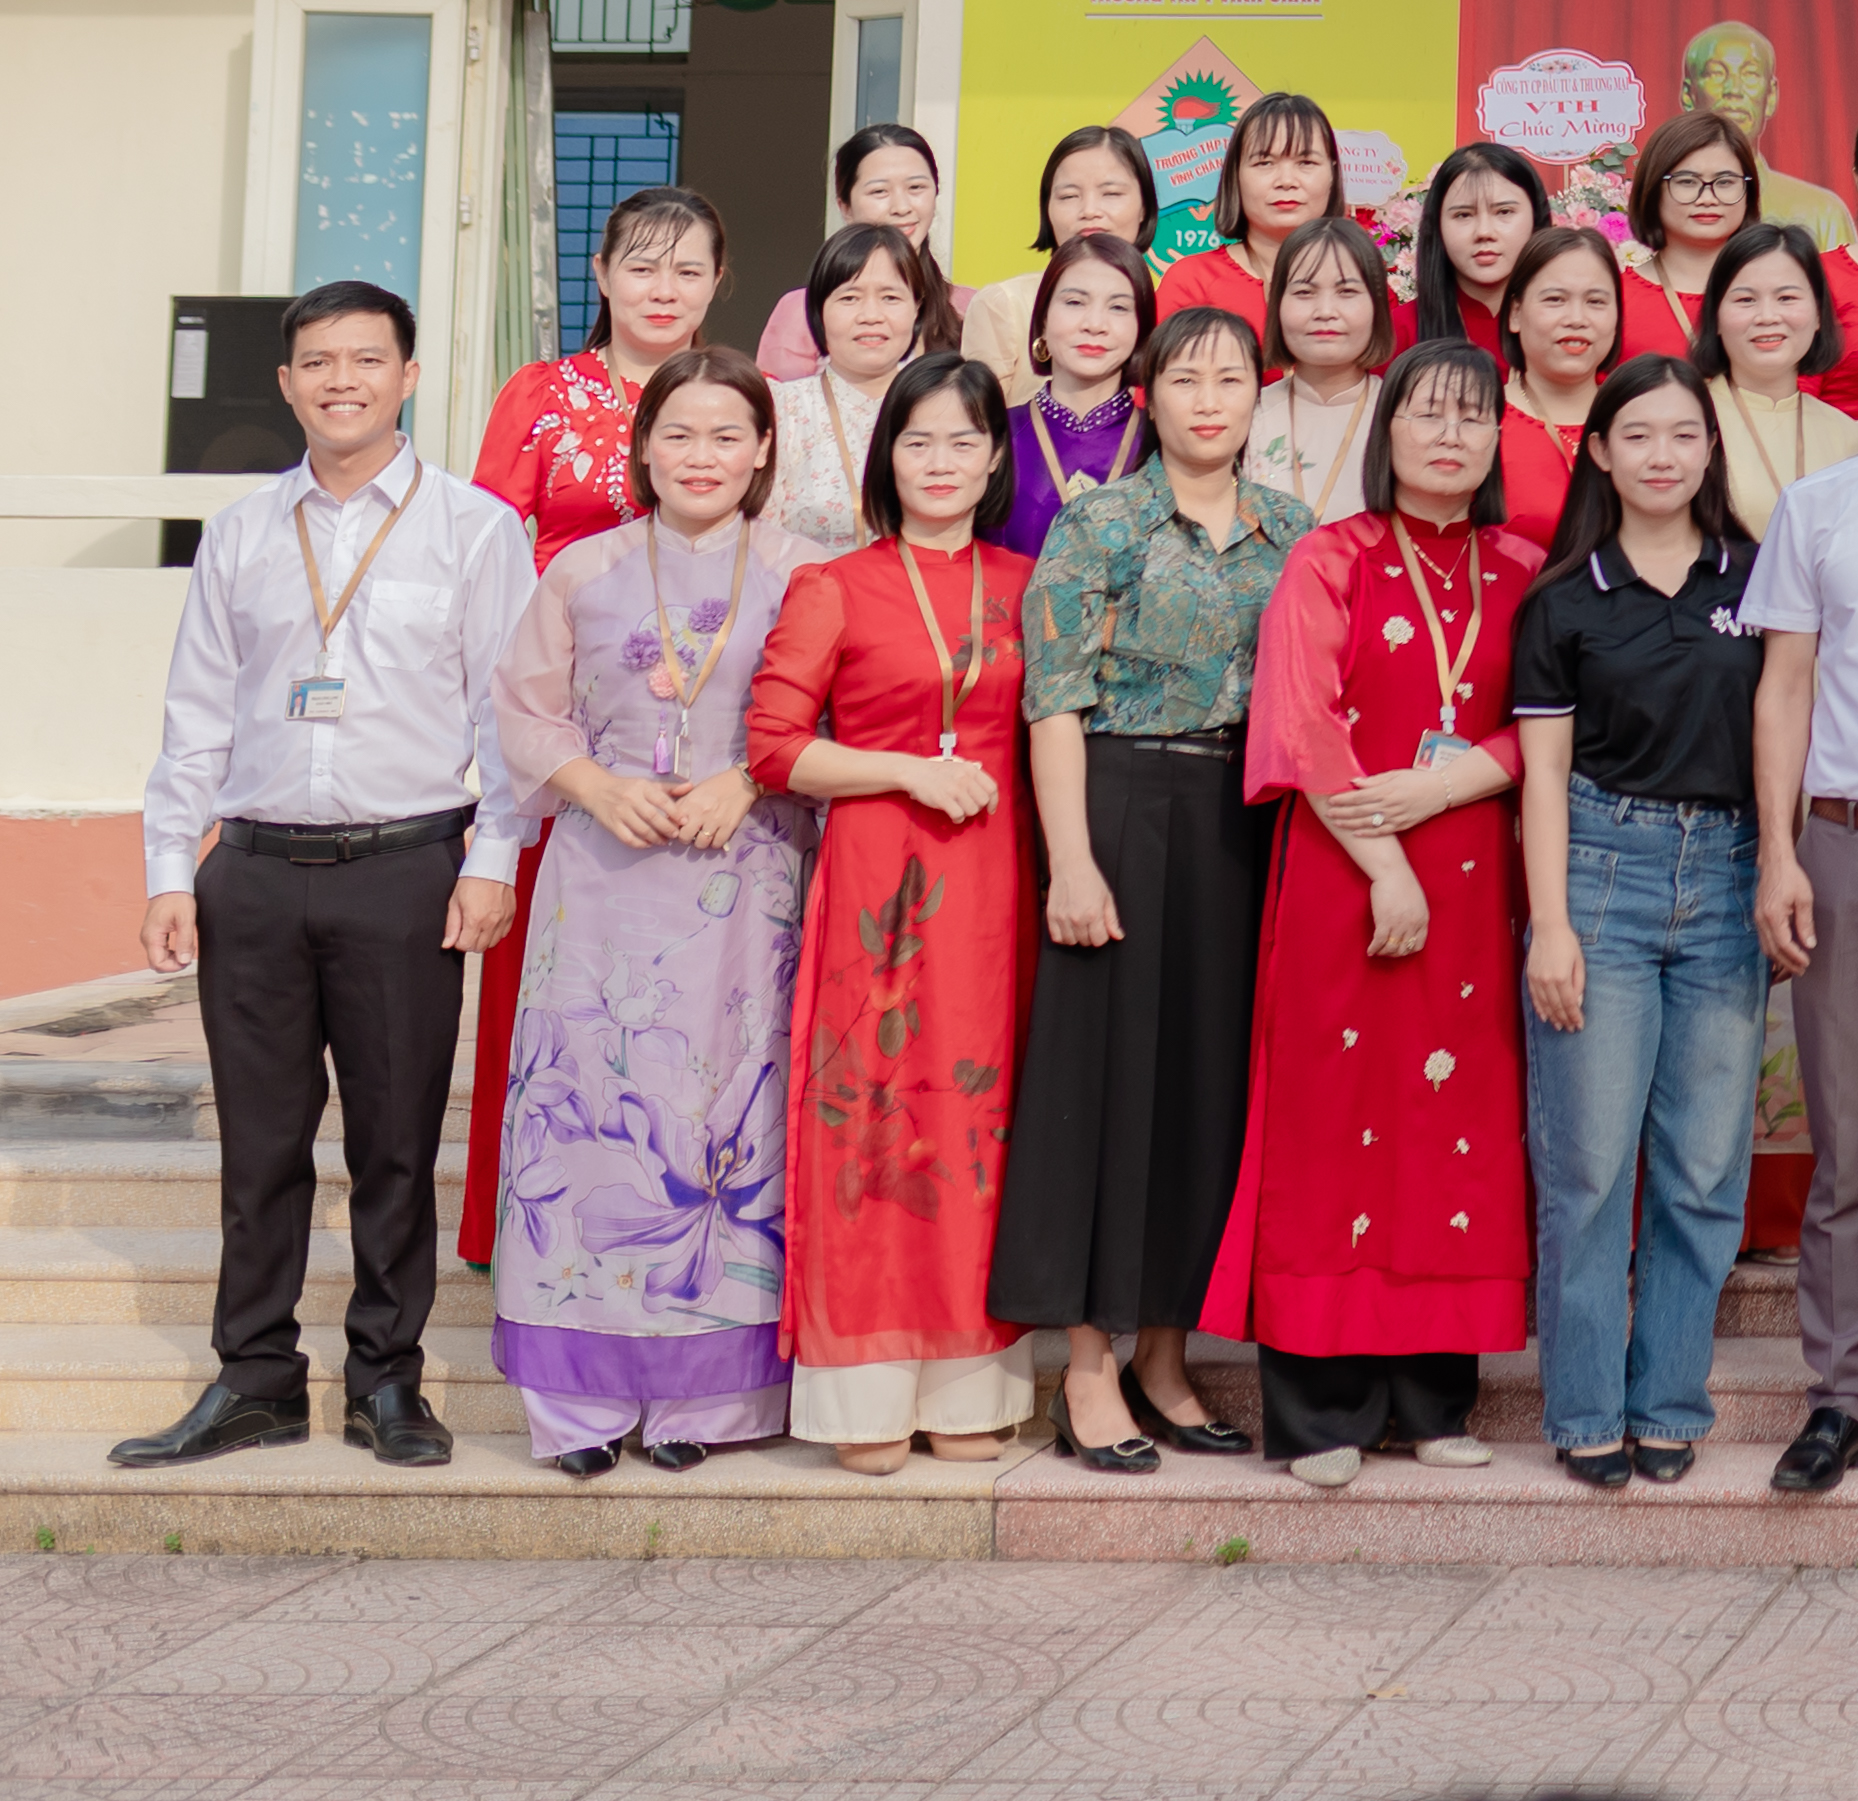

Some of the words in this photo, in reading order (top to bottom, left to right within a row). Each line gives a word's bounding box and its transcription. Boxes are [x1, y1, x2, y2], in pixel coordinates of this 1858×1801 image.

[1520, 81, 1529, 94] TY
[1525, 100, 1600, 115] VTH
[1499, 120, 1554, 137] Chúc
[1561, 118, 1626, 138] Mừng
[1155, 147, 1198, 171] TRƯỜNG
[1170, 169, 1194, 187] VĨNH
[1176, 229, 1220, 248] 1976
